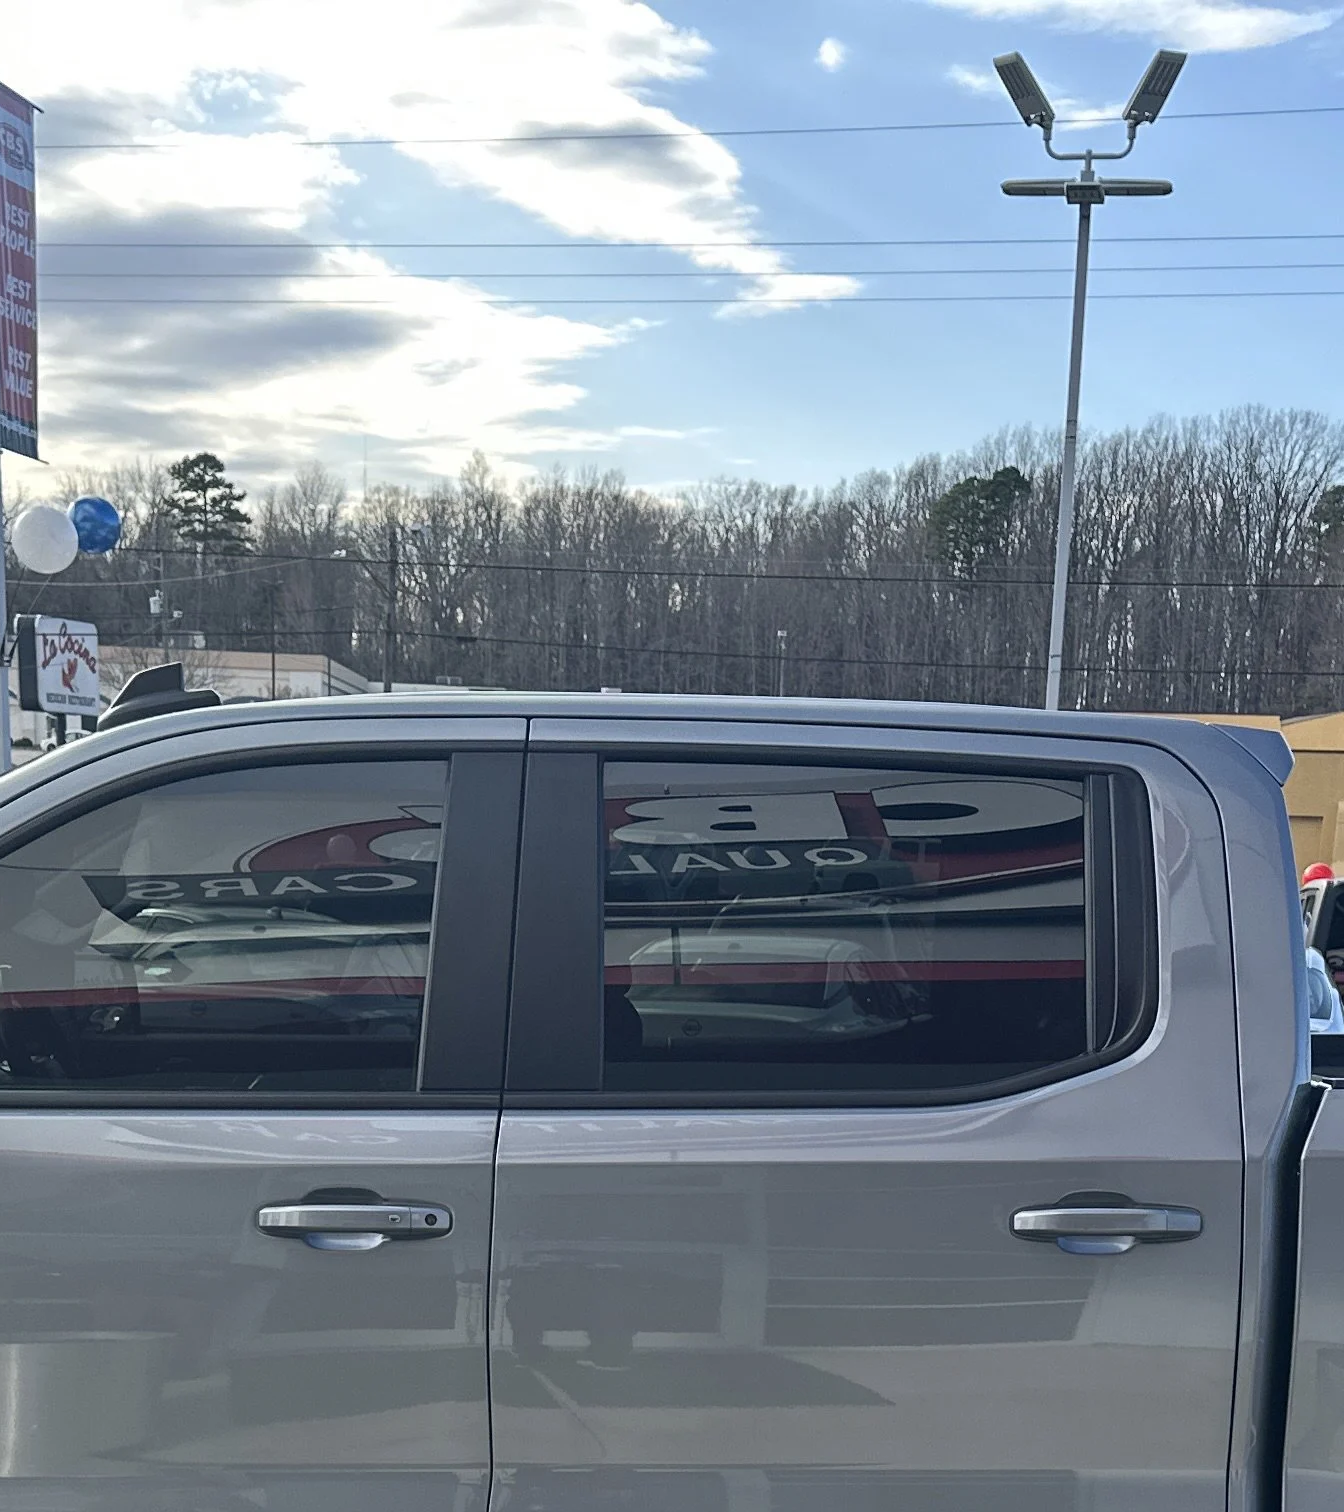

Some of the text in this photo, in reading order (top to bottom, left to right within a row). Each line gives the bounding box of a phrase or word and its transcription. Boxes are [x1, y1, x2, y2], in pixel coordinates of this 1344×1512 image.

[0, 127, 24, 156] CBS
[5, 200, 31, 230] BEST
[0, 224, 35, 259] PEOPLE
[6, 274, 31, 302] BEST
[7, 345, 32, 372] BEST
[3, 369, 33, 399] VALUE
